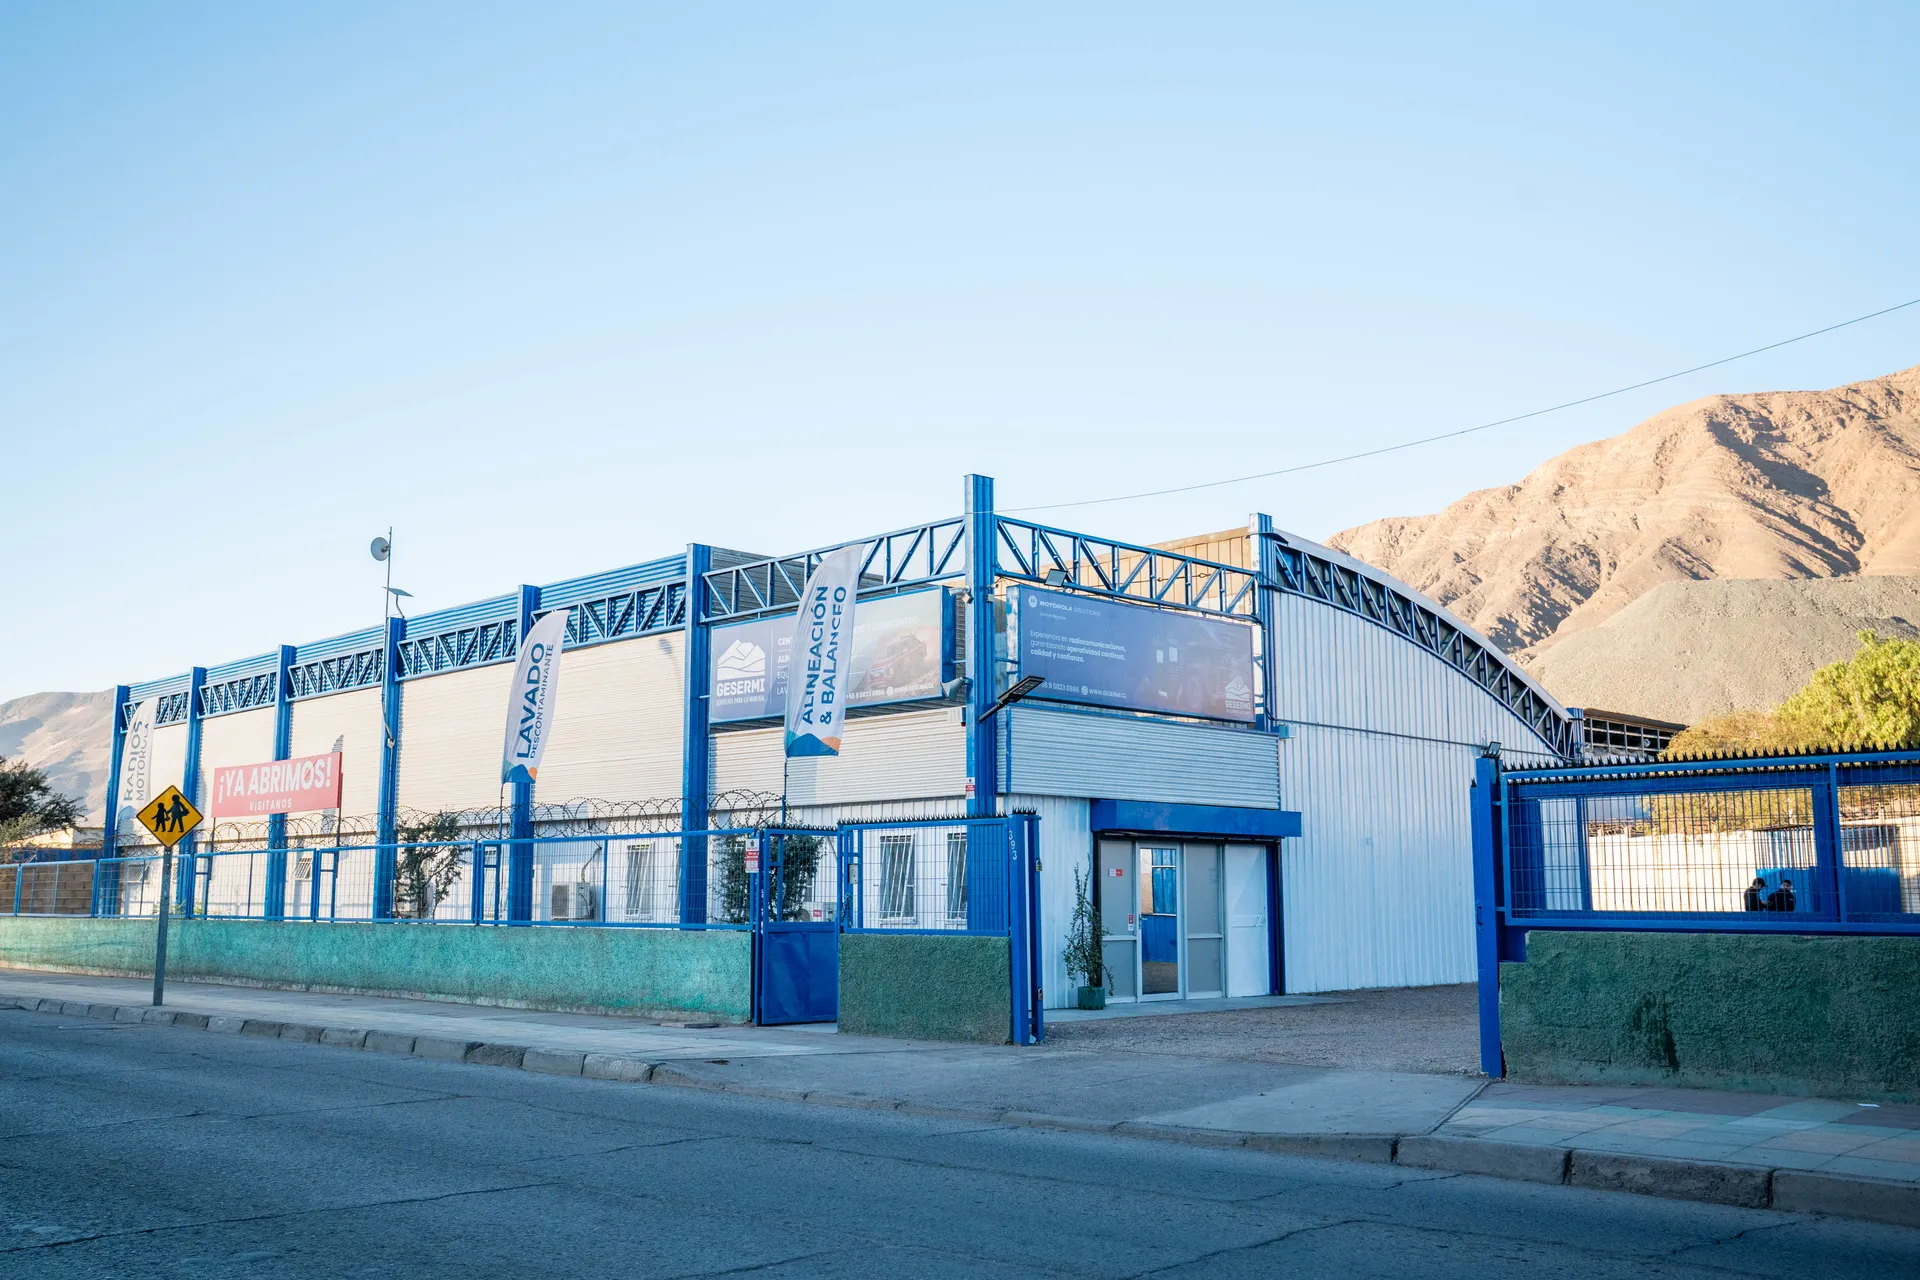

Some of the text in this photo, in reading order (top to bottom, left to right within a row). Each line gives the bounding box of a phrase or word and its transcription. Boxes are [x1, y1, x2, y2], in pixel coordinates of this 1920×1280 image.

[1040, 600, 1101, 617] MOTOROLA SOLUTIONS
[1030, 630, 1061, 641] Experiencia
[1030, 640, 1067, 651] garantizando
[802, 586, 828, 725] ALINEACIÓN
[819, 586, 847, 725] & BALANCEO
[1030, 648, 1052, 658] calidad
[1057, 653, 1086, 663] confianza.
[716, 678, 765, 697] GESERMI
[1053, 682, 1066, 691] 5823
[517, 643, 545, 758] LAVADO
[530, 644, 554, 759] DESCONTAMINANTE
[1224, 700, 1251, 710] GESERMI
[124, 720, 142, 801] RADIOS
[218, 757, 332, 804] ¡YA ABRIMOS!
[249, 798, 292, 812] VISITANOS
[1008, 829, 1018, 861] 393
